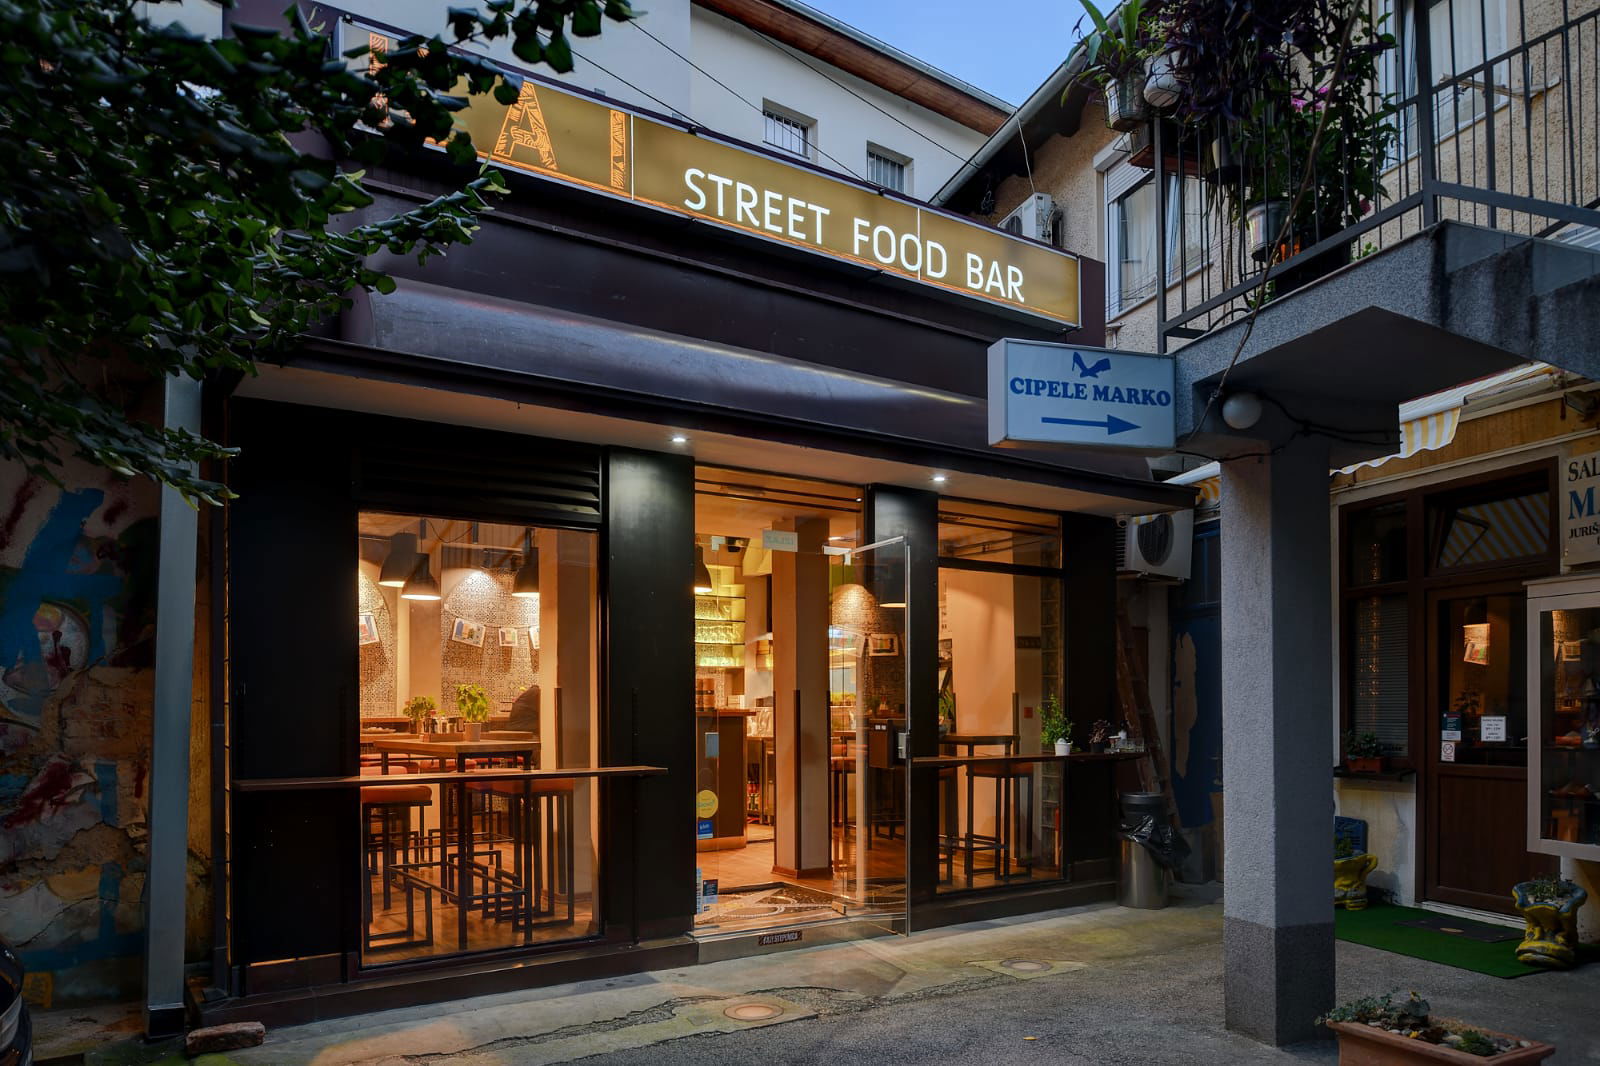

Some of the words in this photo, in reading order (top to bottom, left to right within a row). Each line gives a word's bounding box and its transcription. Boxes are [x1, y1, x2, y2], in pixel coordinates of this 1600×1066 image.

[684, 168, 830, 245] STREET
[853, 217, 948, 279] FOOD
[967, 252, 1025, 303] BAR
[1009, 376, 1088, 401] CIPELE
[1092, 384, 1172, 407] MARKO
